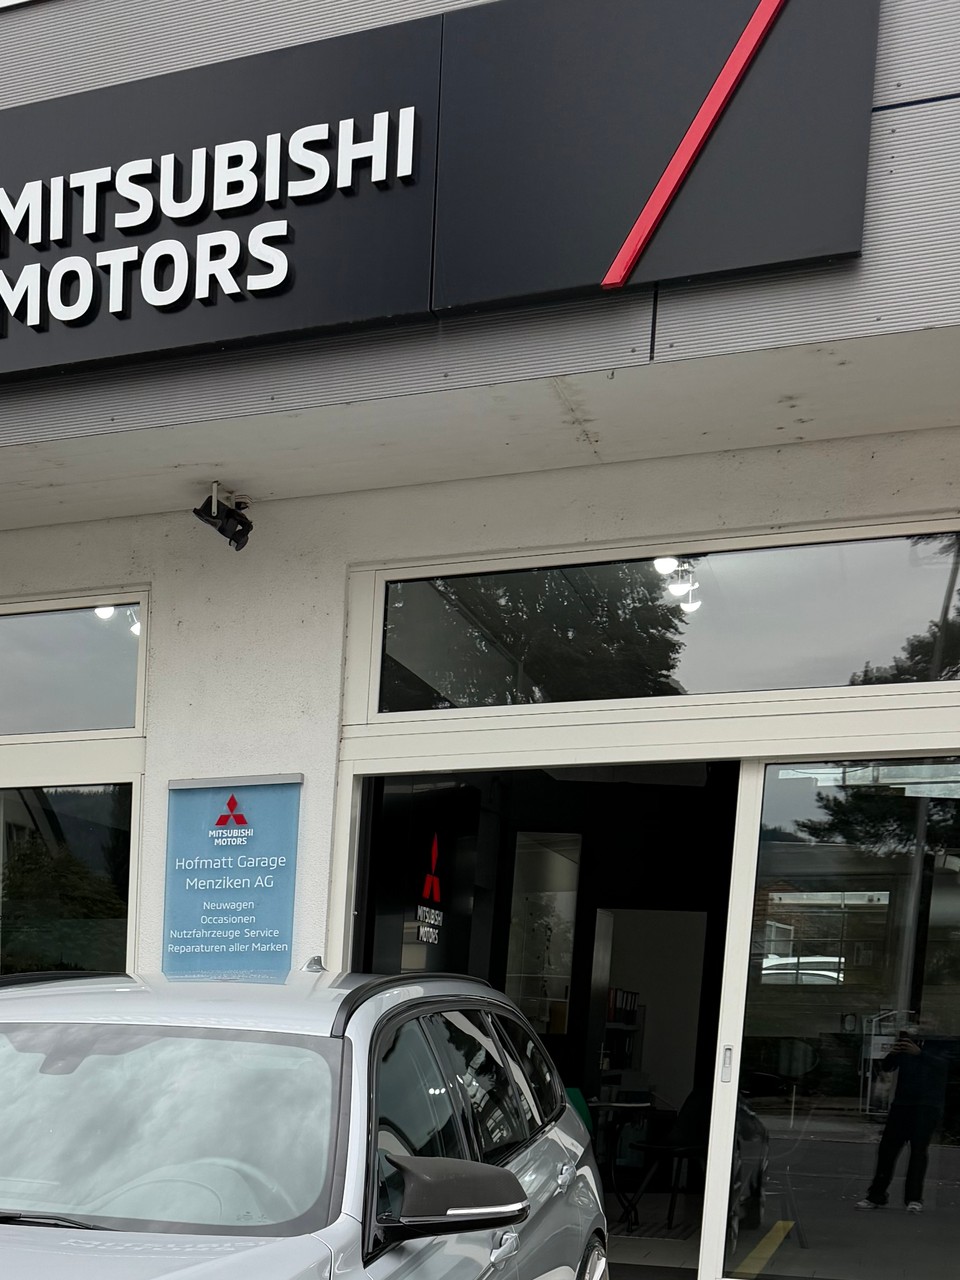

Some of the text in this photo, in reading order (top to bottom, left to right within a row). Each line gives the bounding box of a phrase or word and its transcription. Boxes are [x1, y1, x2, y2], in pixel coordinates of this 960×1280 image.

[208, 828, 254, 838] MITSUBISHI
[214, 837, 247, 846] MOTORS
[175, 855, 287, 870] Hofmatt Garage
[185, 875, 274, 890] Menziken AG
[203, 901, 255, 912] Neuwagen
[200, 915, 256, 924] Occasionen
[170, 928, 280, 940] Nutzfahrzeuge Service
[168, 942, 288, 955] Reparaturen aller Marken
